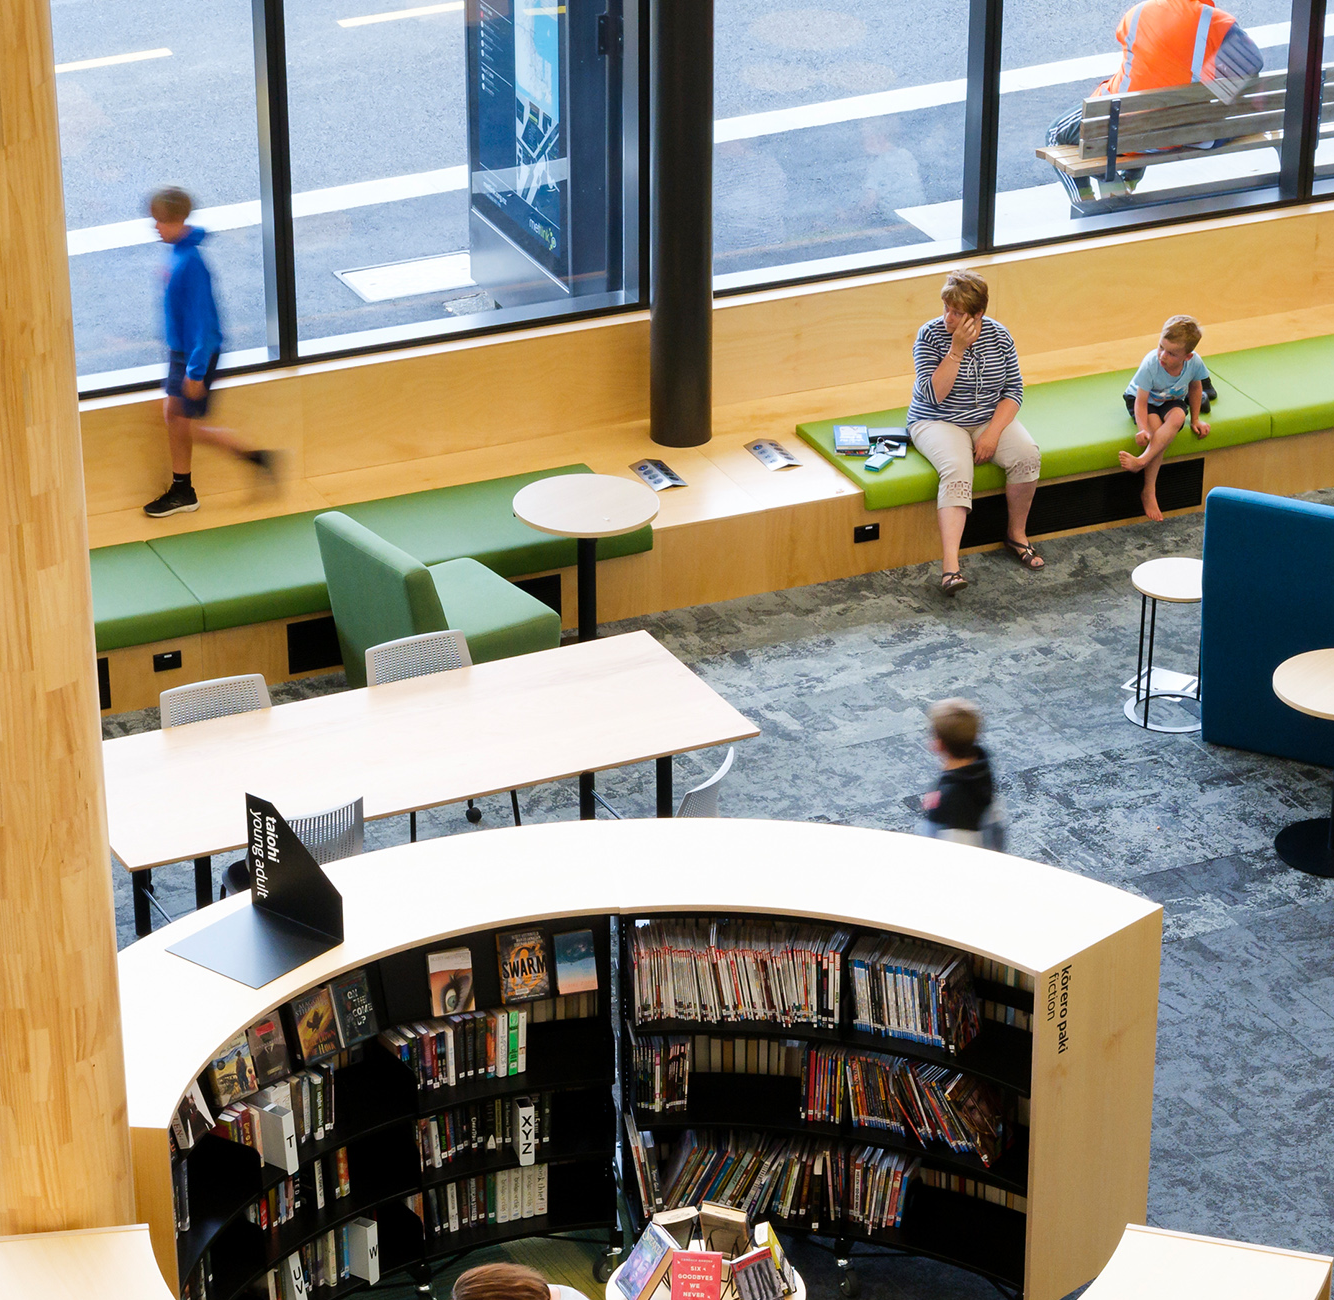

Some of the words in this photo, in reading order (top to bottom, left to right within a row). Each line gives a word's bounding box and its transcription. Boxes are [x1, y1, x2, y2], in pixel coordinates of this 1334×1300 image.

[250, 808, 264, 859] young
[266, 815, 280, 864] taiohi
[255, 858, 269, 899] adult
[502, 955, 548, 980] SWARM
[1047, 972, 1059, 1022] fiction
[1059, 964, 1072, 1019] kōrero
[1057, 1020, 1069, 1055] paki
[286, 1134, 294, 1148] T
[369, 1244, 378, 1260] W
[677, 1273, 714, 1281] GOODBYES
